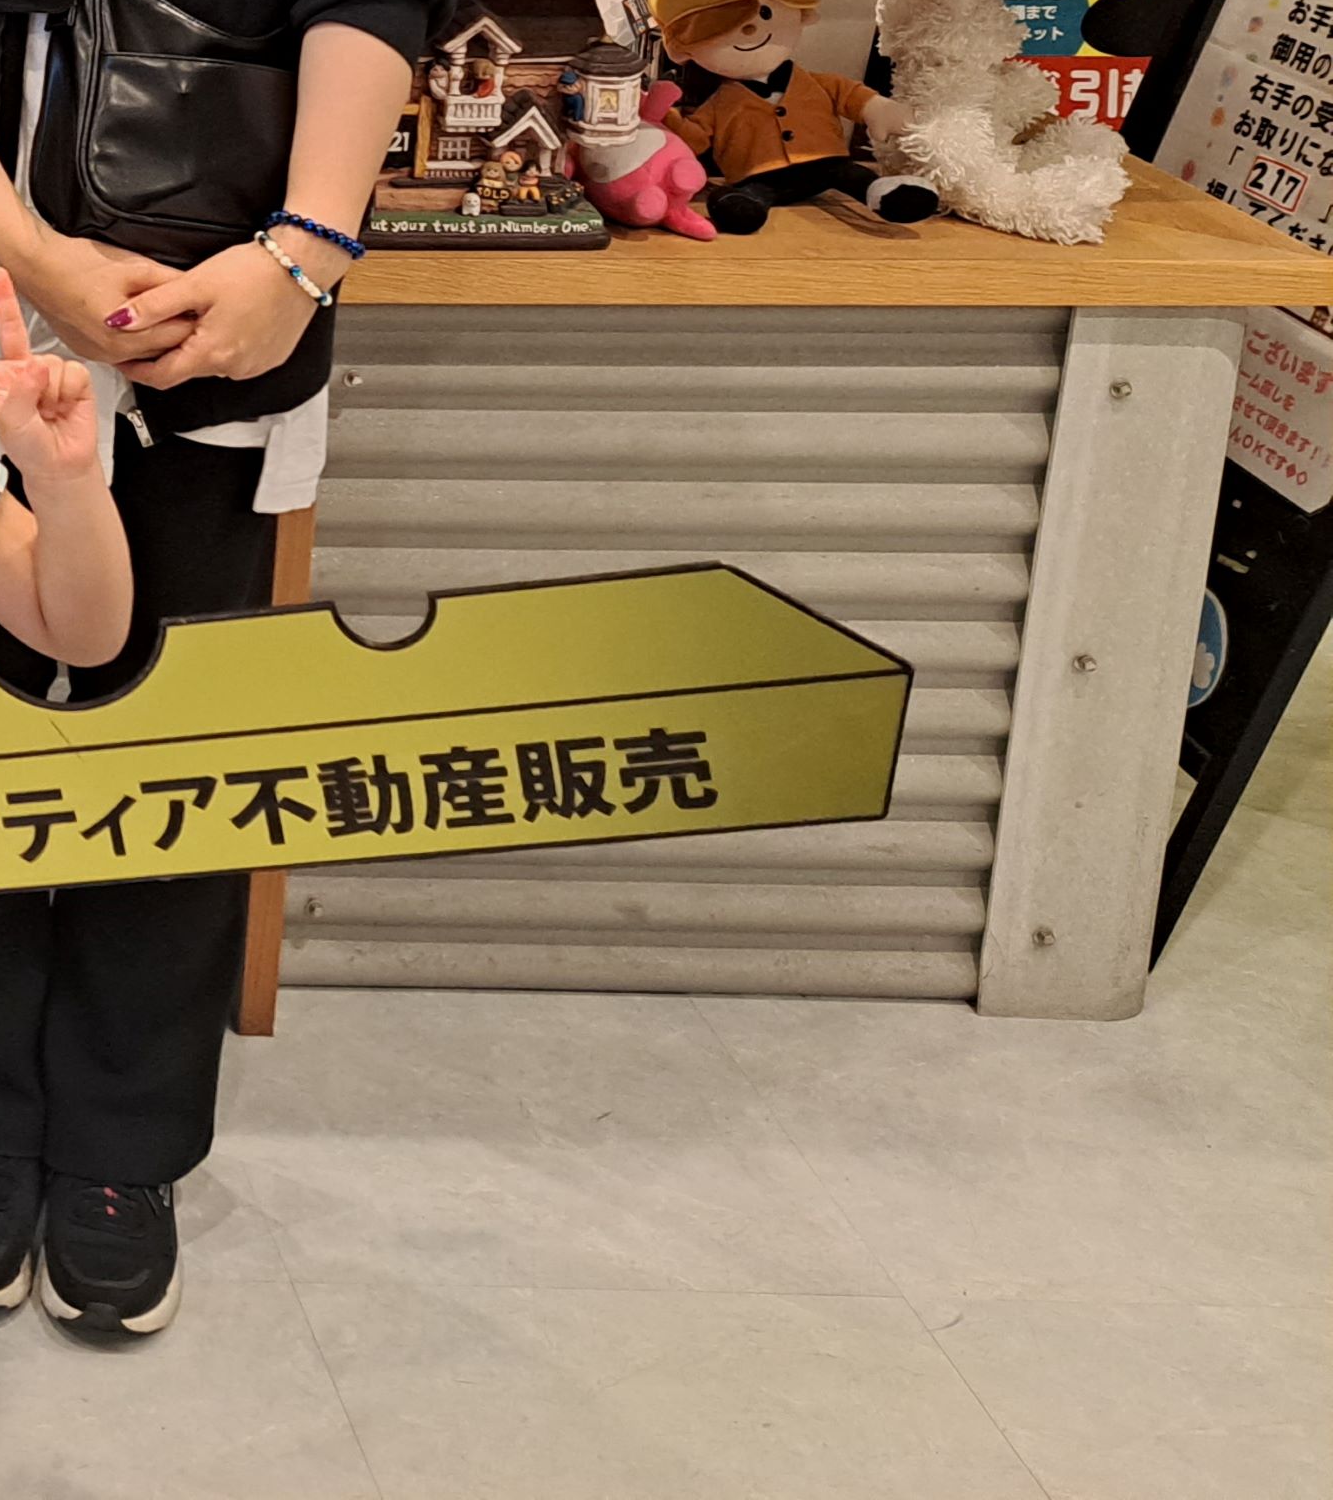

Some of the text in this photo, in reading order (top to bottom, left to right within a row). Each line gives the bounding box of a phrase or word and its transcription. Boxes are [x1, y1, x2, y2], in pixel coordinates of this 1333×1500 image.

[1270, 32, 1333, 86] 御用の
[1249, 73, 1333, 136] 右手の受
[389, 132, 410, 152] 21
[1233, 109, 1333, 178] お取りにな
[478, 185, 512, 199] SOLD
[1248, 162, 1301, 204] 217
[390, 220, 428, 233] your
[433, 219, 476, 233] trust
[480, 220, 497, 233] in
[499, 220, 557, 233] Number
